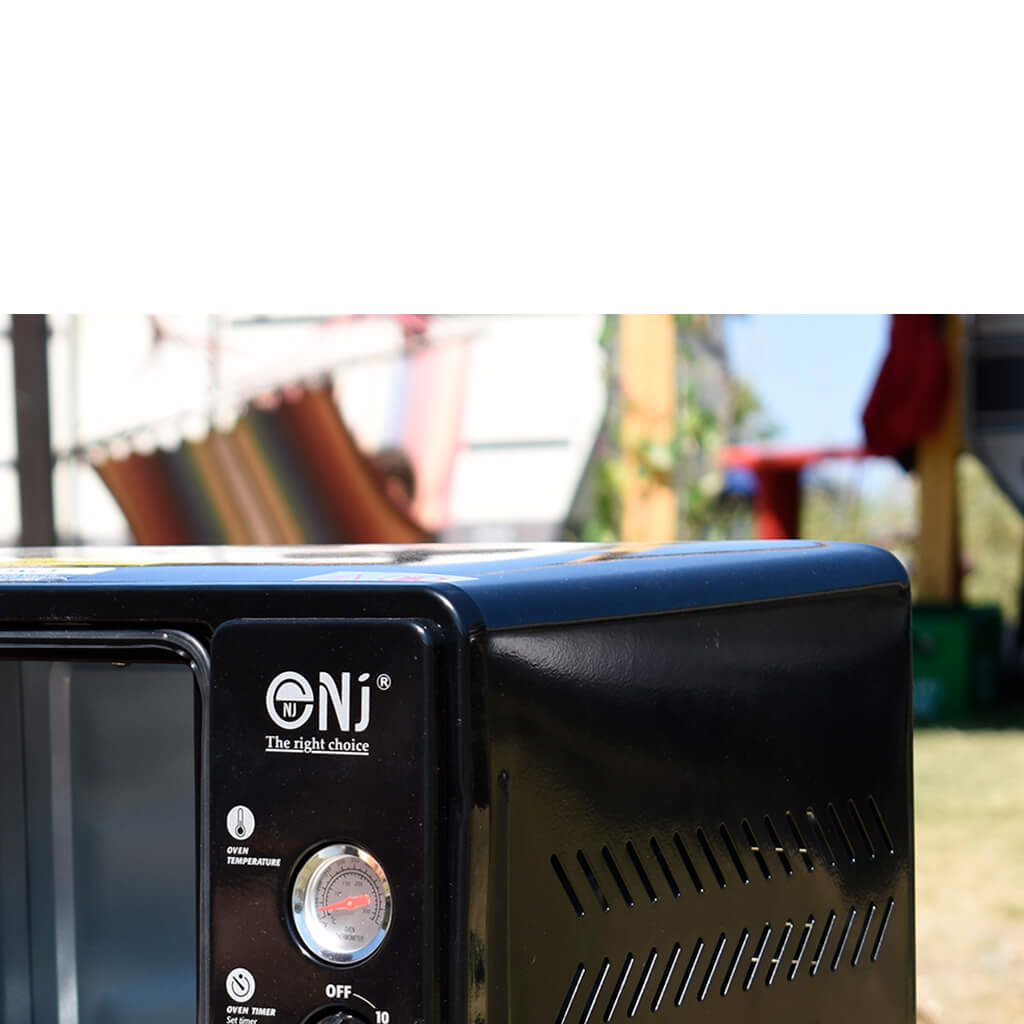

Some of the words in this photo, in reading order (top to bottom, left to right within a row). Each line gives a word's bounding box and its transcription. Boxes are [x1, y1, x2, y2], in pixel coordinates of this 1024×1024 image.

[265, 735, 291, 750] The
[294, 737, 325, 753] right
[328, 738, 370, 752] choice
[227, 846, 249, 854] OVEN
[227, 857, 281, 866] TEMPERATURE
[326, 984, 351, 998] OFF
[226, 1006, 248, 1015] OVEN
[251, 1008, 276, 1017] TIMER
[226, 1016, 238, 1024] Set
[376, 1011, 389, 1024] 10
